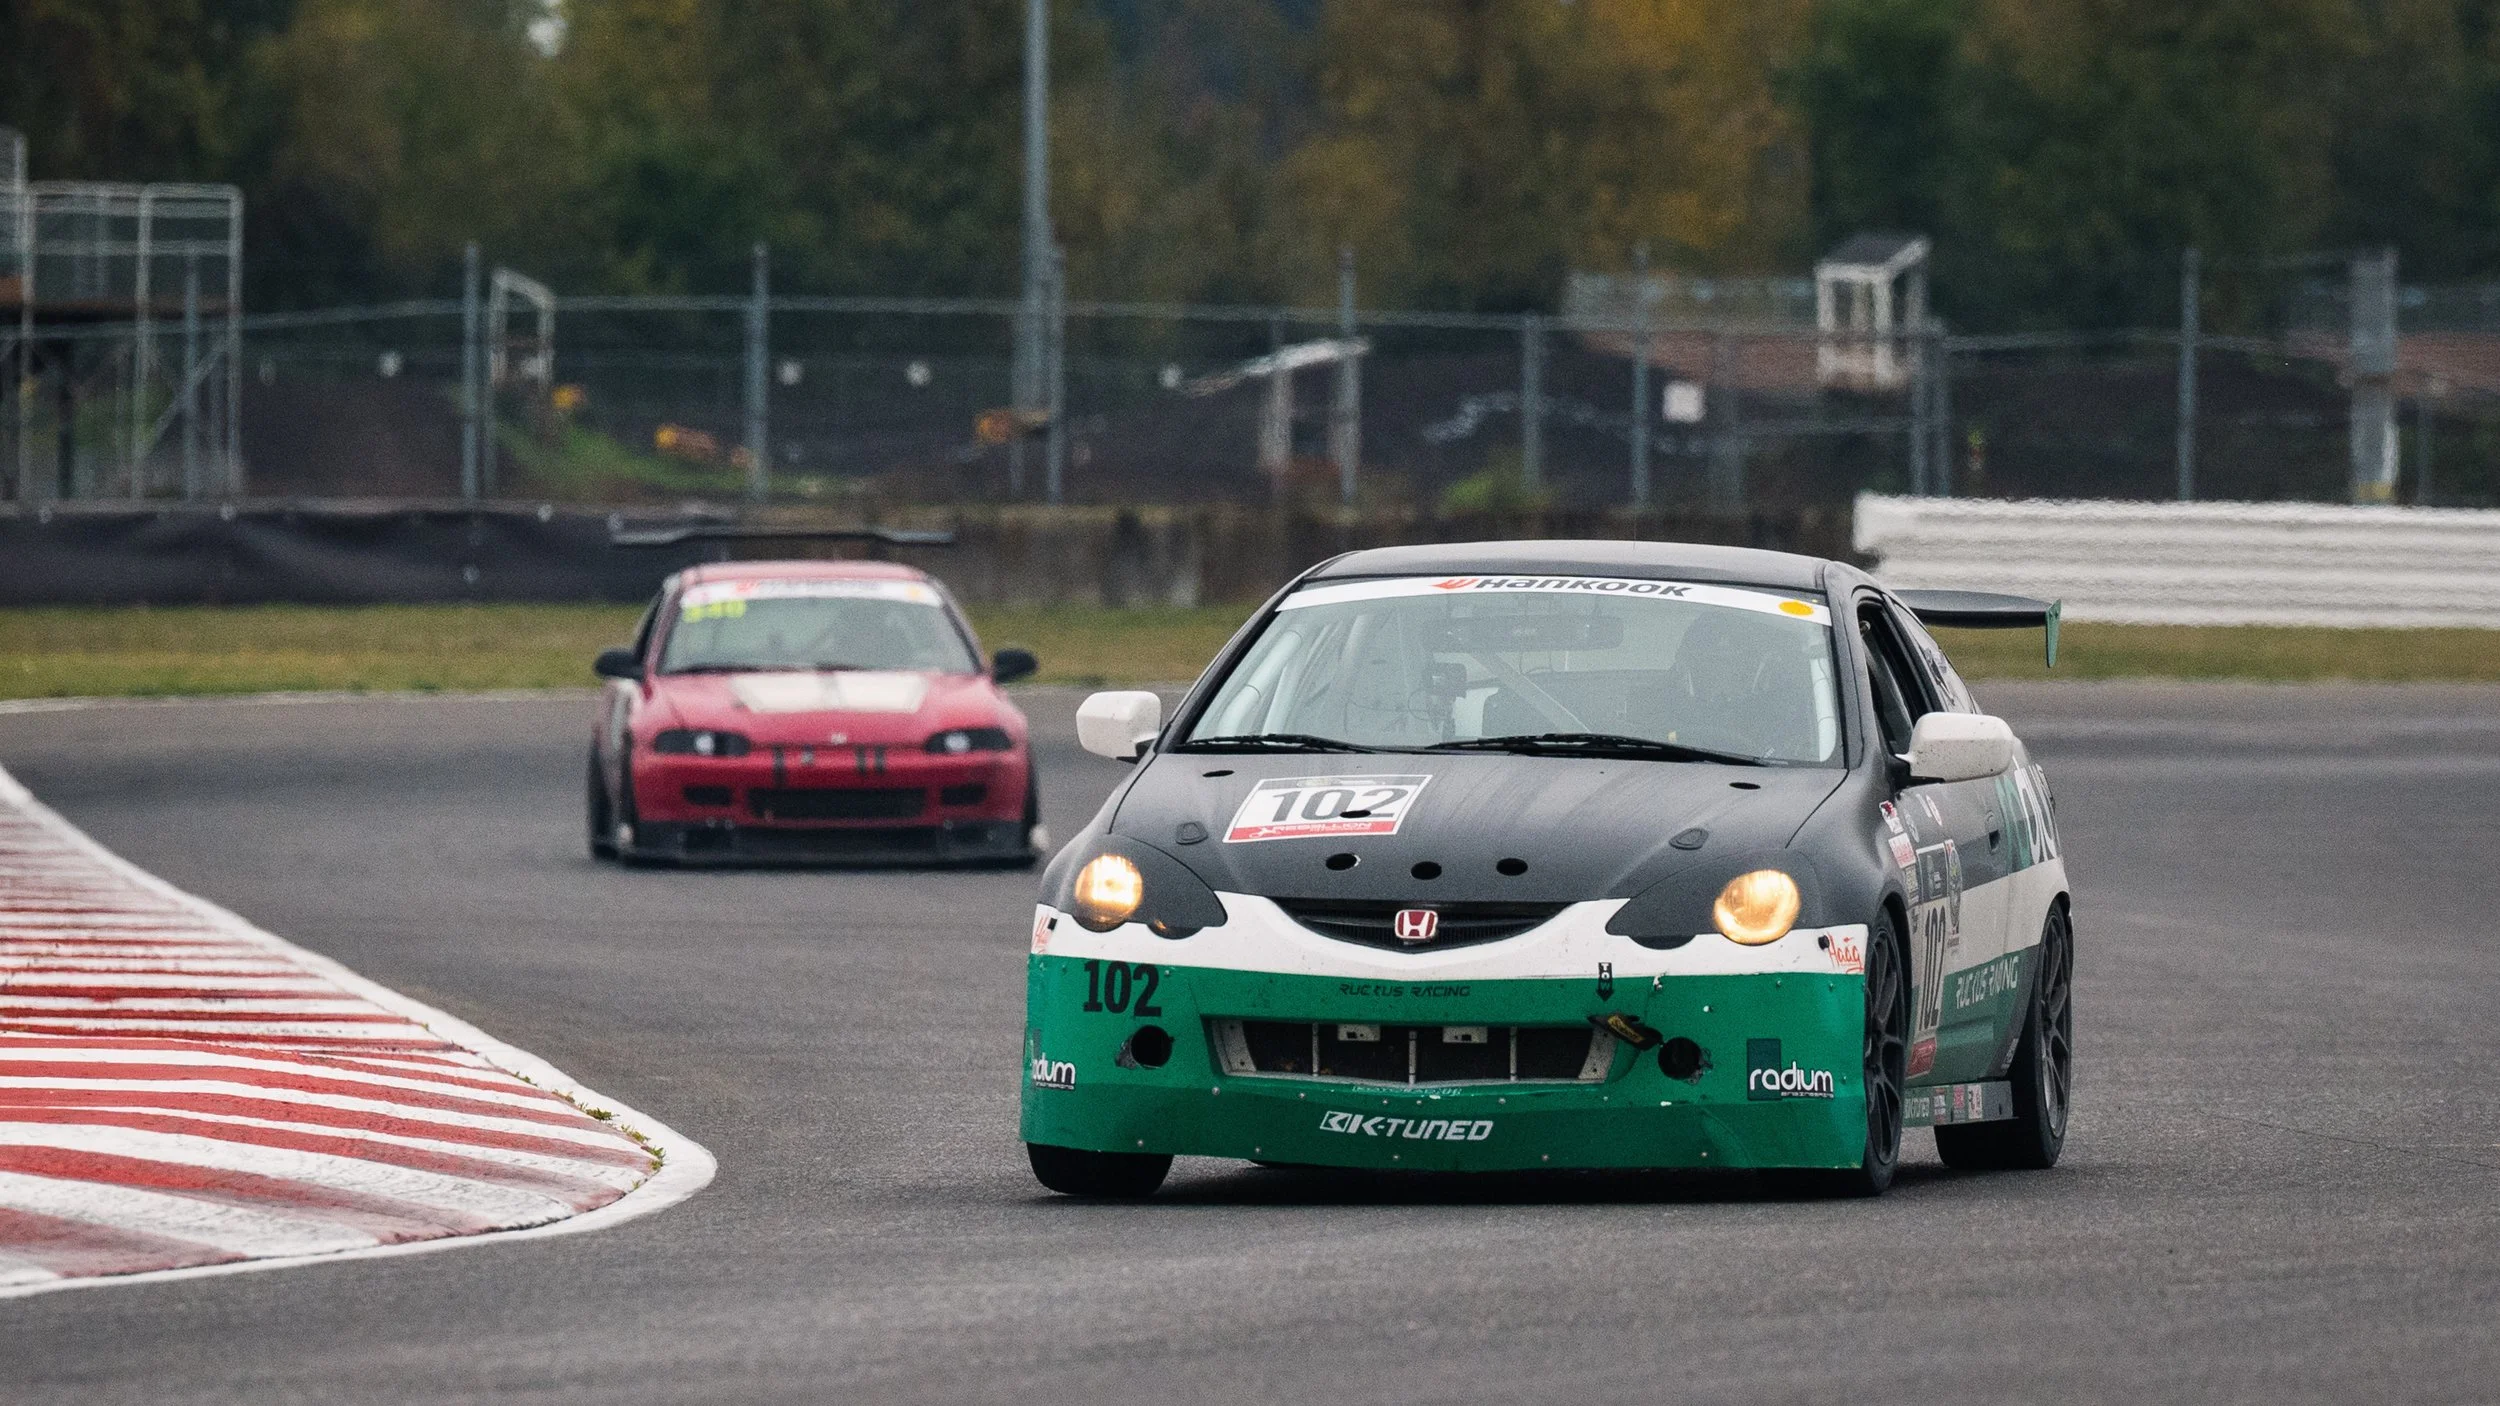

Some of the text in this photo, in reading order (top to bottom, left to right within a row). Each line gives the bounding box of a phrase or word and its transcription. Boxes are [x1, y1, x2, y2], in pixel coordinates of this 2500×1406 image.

[1271, 789, 1409, 822] 102
[1919, 904, 1946, 1031] 102
[1083, 959, 1162, 1017] 102
[1411, 985, 1472, 997] RACING
[1749, 1060, 1834, 1092] radium
[1347, 1113, 1494, 1141] K-TUNED
